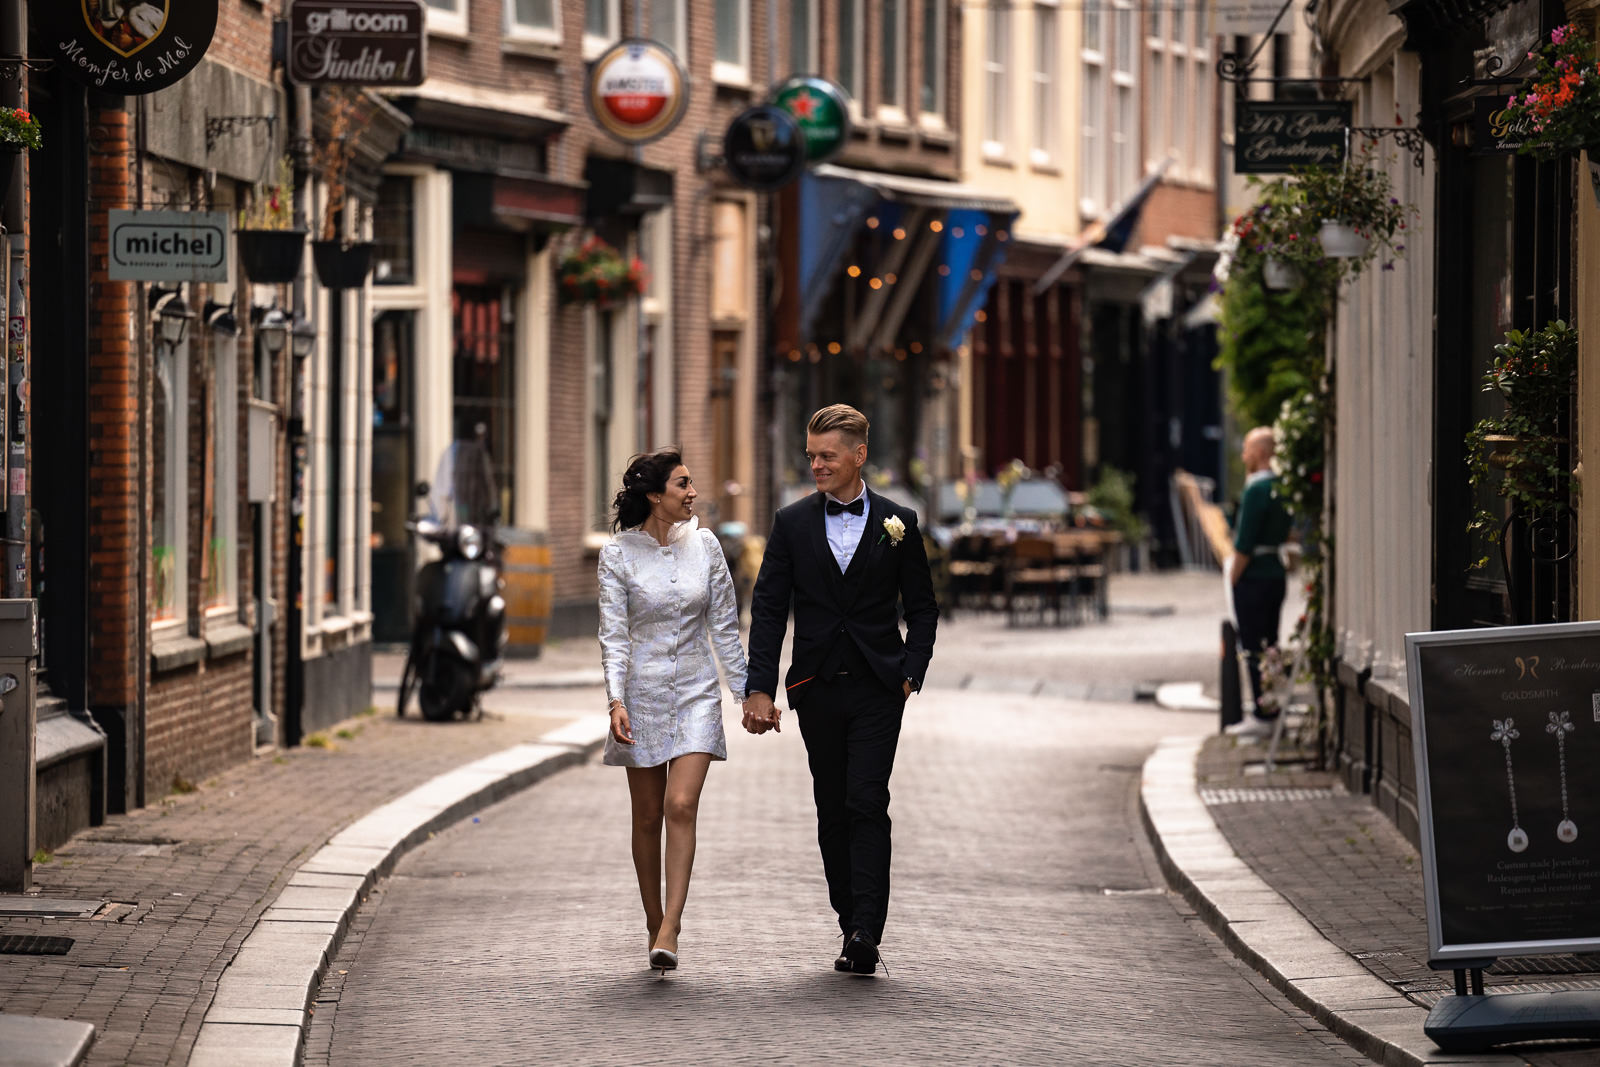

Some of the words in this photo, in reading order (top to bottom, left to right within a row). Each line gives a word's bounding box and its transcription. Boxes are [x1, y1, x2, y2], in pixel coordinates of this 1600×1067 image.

[306, 8, 408, 34] grillroom
[59, 39, 130, 86] Momfer
[134, 60, 154, 82] de
[158, 35, 193, 75] Mol
[126, 231, 212, 255] michel
[1453, 663, 1506, 677] Herman
[1500, 688, 1560, 701] GOLDSMITH
